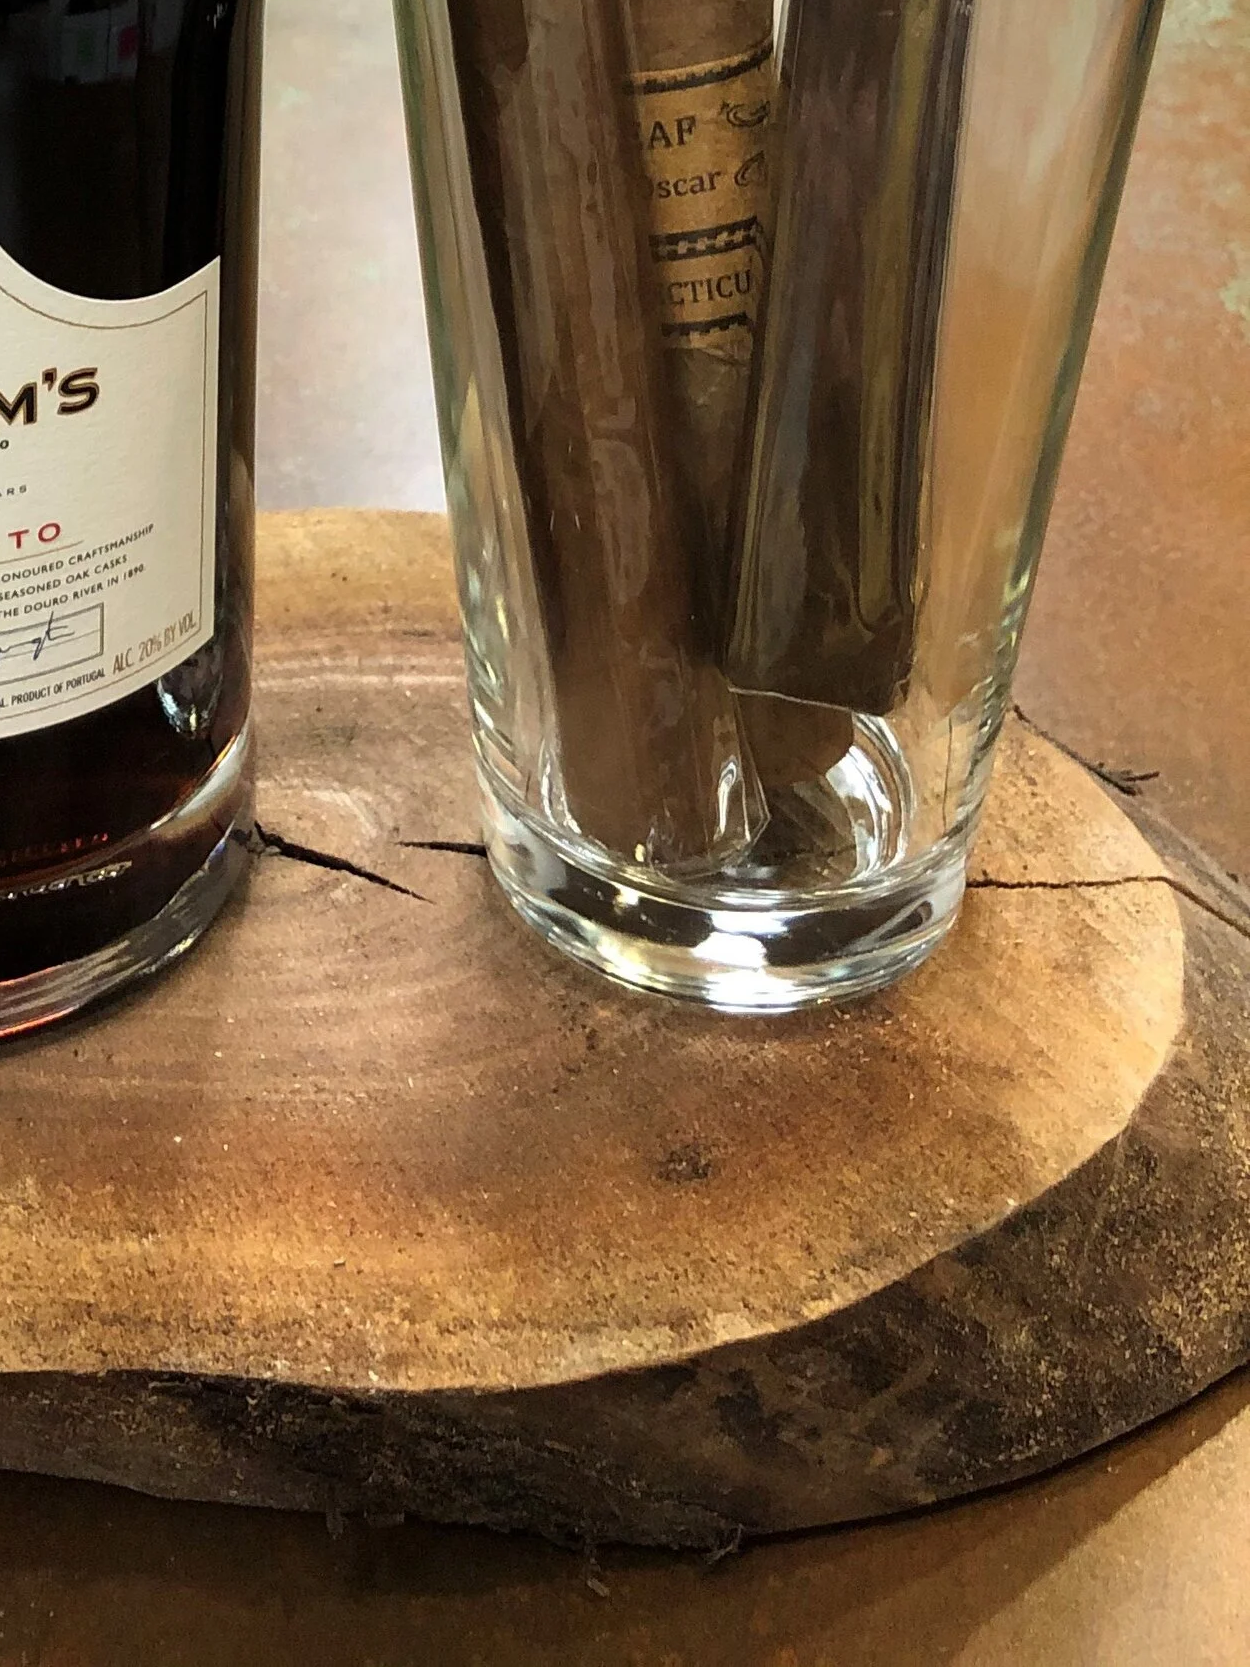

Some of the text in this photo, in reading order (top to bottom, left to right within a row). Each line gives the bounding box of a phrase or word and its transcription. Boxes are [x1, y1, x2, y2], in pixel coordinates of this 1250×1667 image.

[646, 115, 698, 151] AF
[644, 167, 723, 200] scar
[67, 523, 154, 567] CRAFTSMANSHIP
[65, 569, 91, 585] OAK
[94, 553, 128, 575] CASKS
[23, 593, 69, 615] DOURO
[72, 581, 104, 601] RIVER
[107, 575, 120, 588] IN
[112, 608, 197, 675] ALC 20% BY VOL
[11, 687, 52, 707] PRODUCT
[53, 681, 65, 696] OF
[66, 667, 106, 692] PORTUGAL
